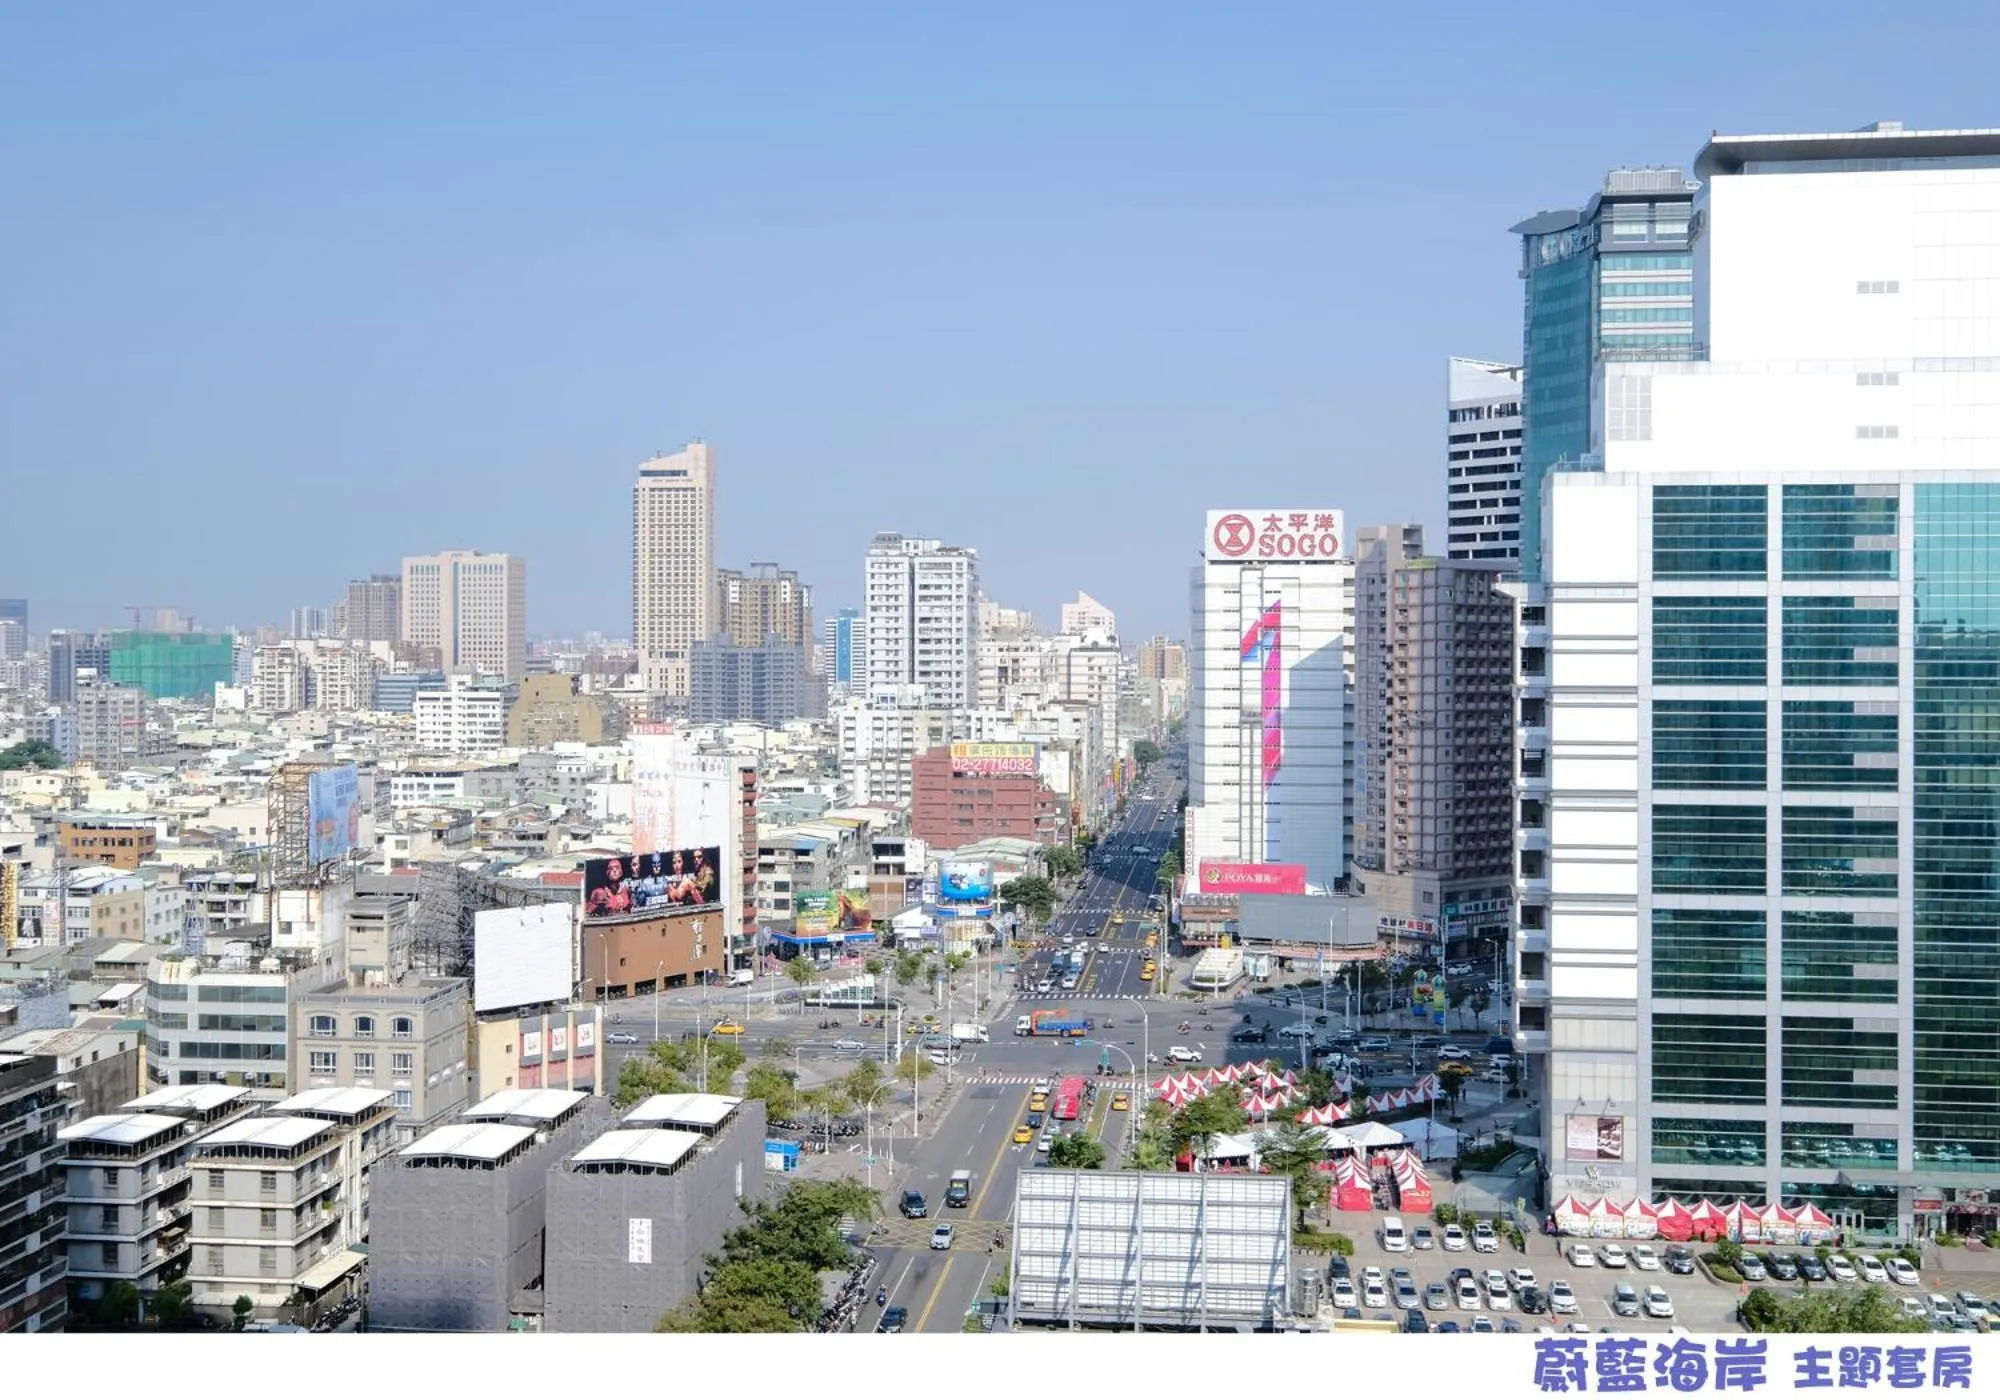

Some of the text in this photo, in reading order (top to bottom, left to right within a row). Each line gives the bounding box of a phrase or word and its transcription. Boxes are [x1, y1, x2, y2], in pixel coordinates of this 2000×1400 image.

[1262, 513, 1335, 532] 太平洋
[1258, 533, 1339, 557] SOGO
[1224, 873, 1252, 883] POYA
